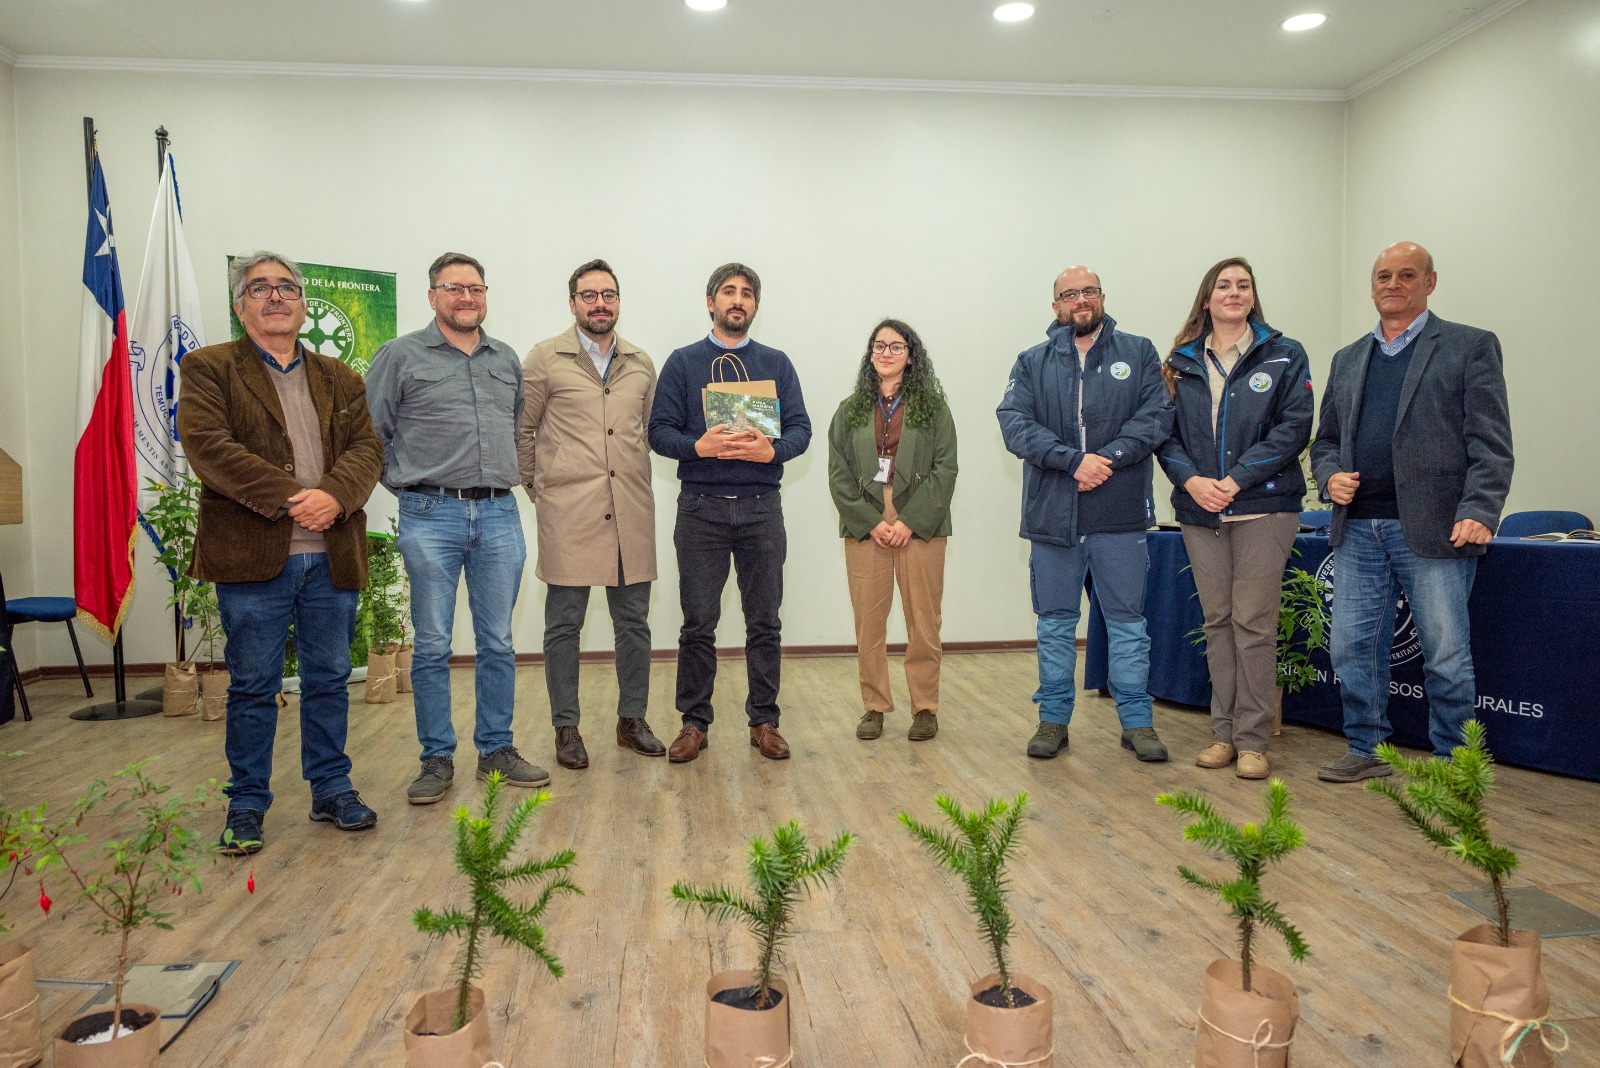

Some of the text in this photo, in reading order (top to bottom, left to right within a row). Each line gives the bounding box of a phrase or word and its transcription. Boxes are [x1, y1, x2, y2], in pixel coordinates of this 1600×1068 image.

[311, 278, 323, 287] DE
[324, 279, 336, 288] LA
[337, 280, 380, 292] FRONTERA
[329, 308, 353, 342] FRONTERA
[137, 430, 159, 460] MENTIS
